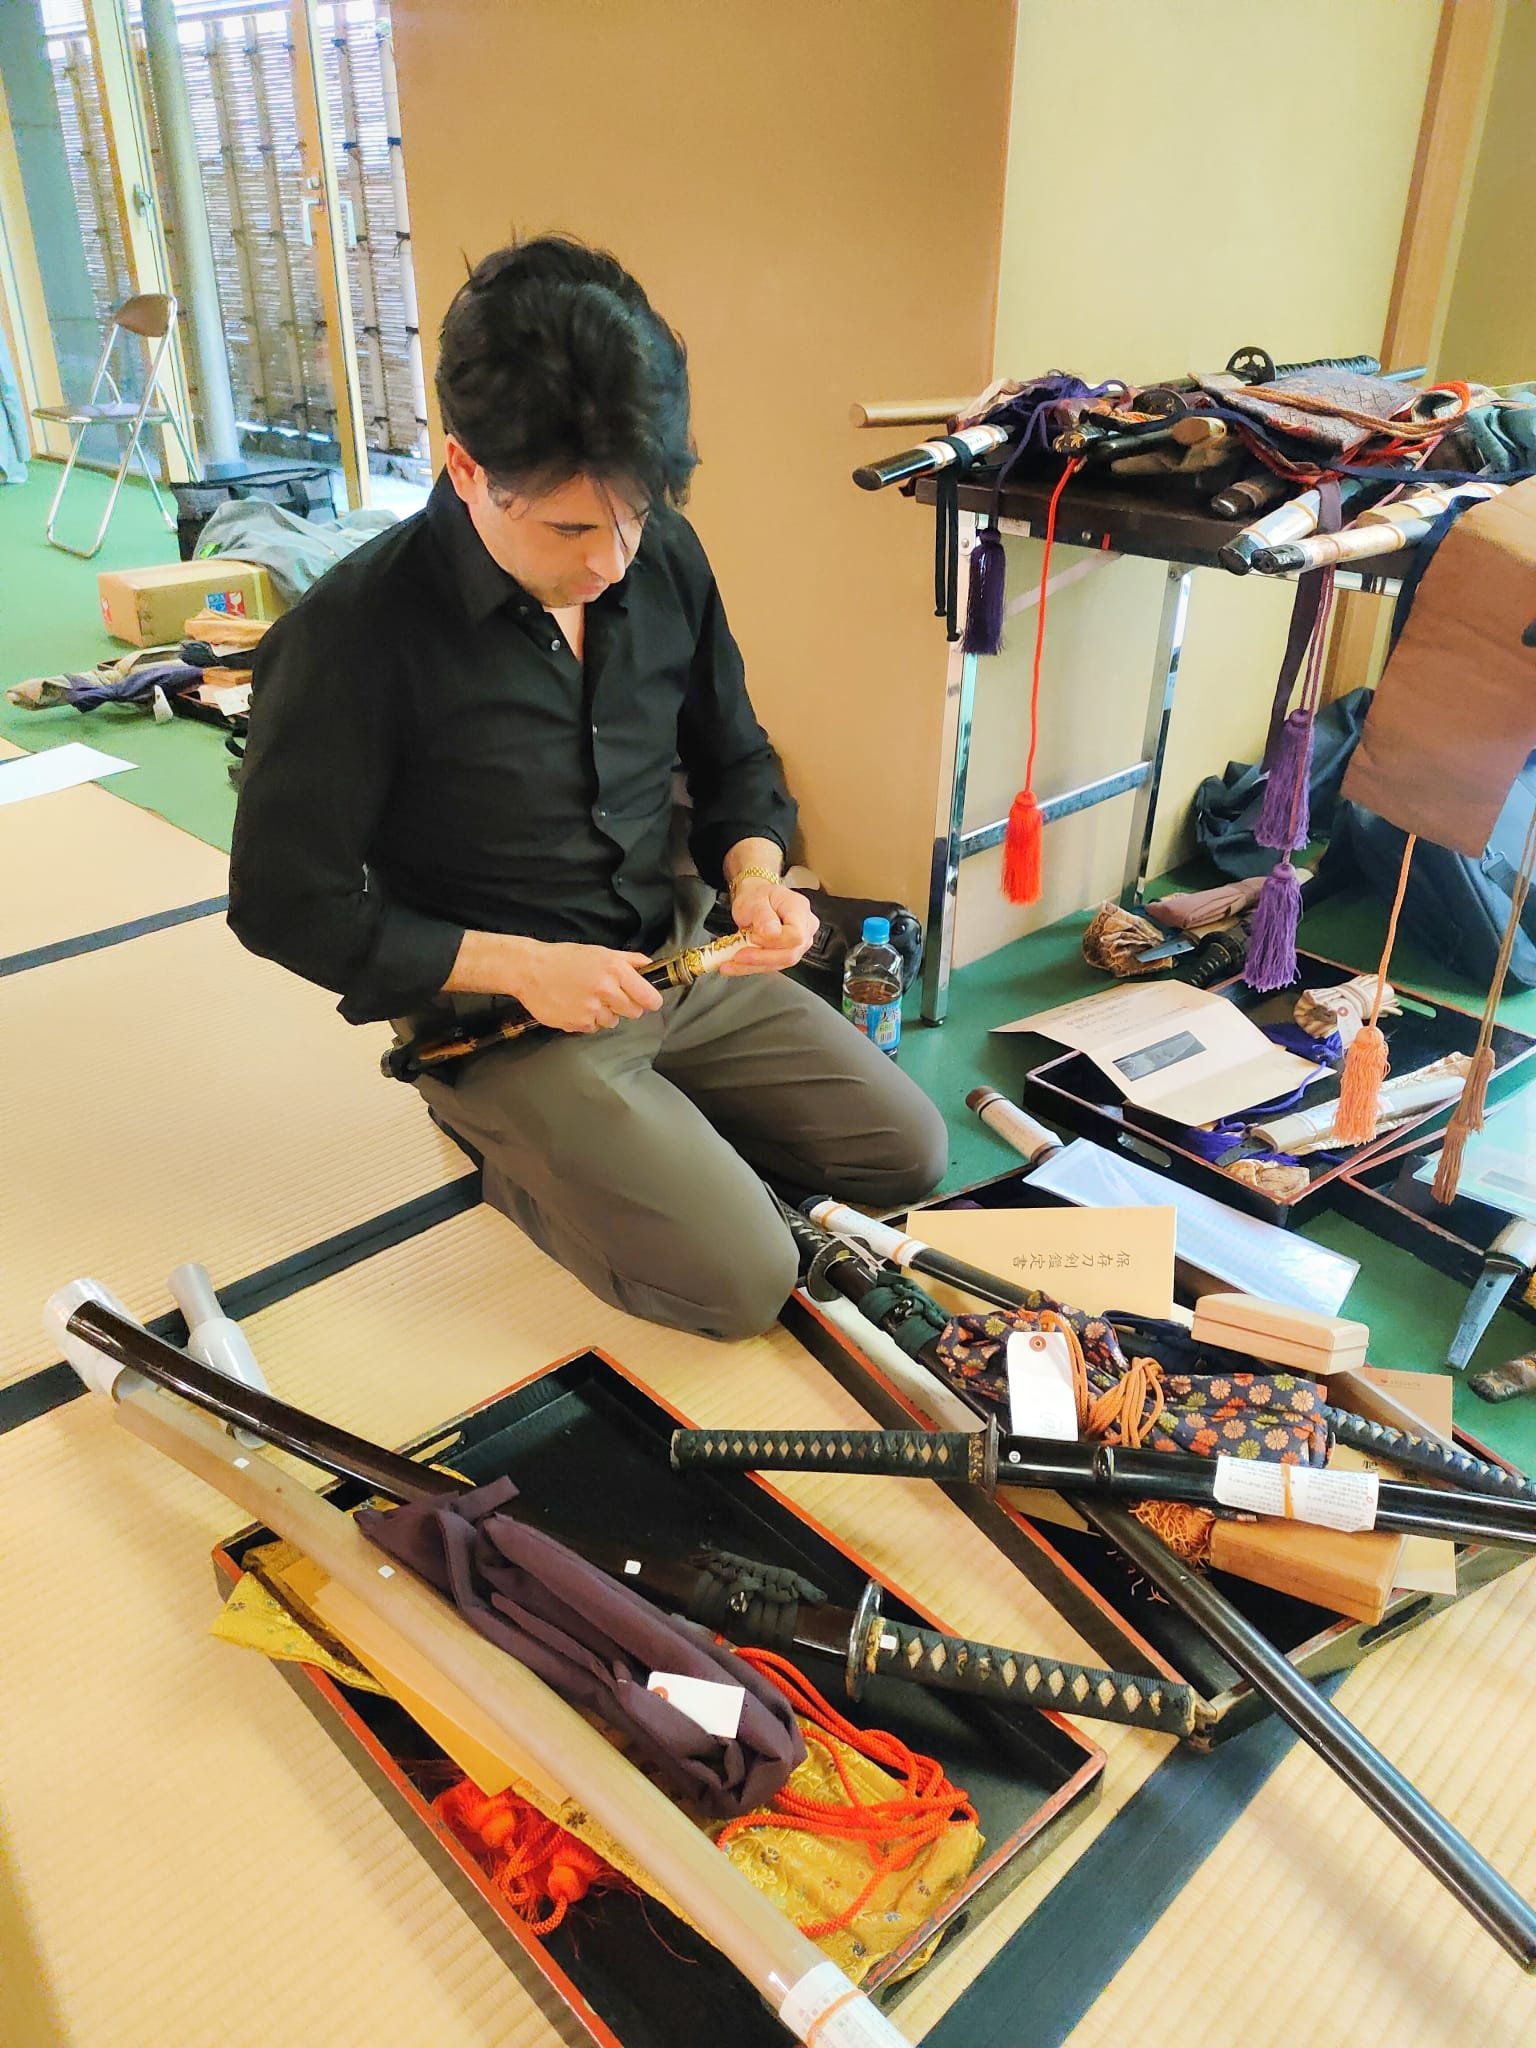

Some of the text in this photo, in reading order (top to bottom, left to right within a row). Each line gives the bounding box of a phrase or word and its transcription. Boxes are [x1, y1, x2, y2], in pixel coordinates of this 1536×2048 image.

[1012, 1251, 1131, 1270] 保存刀剣鑑定書
